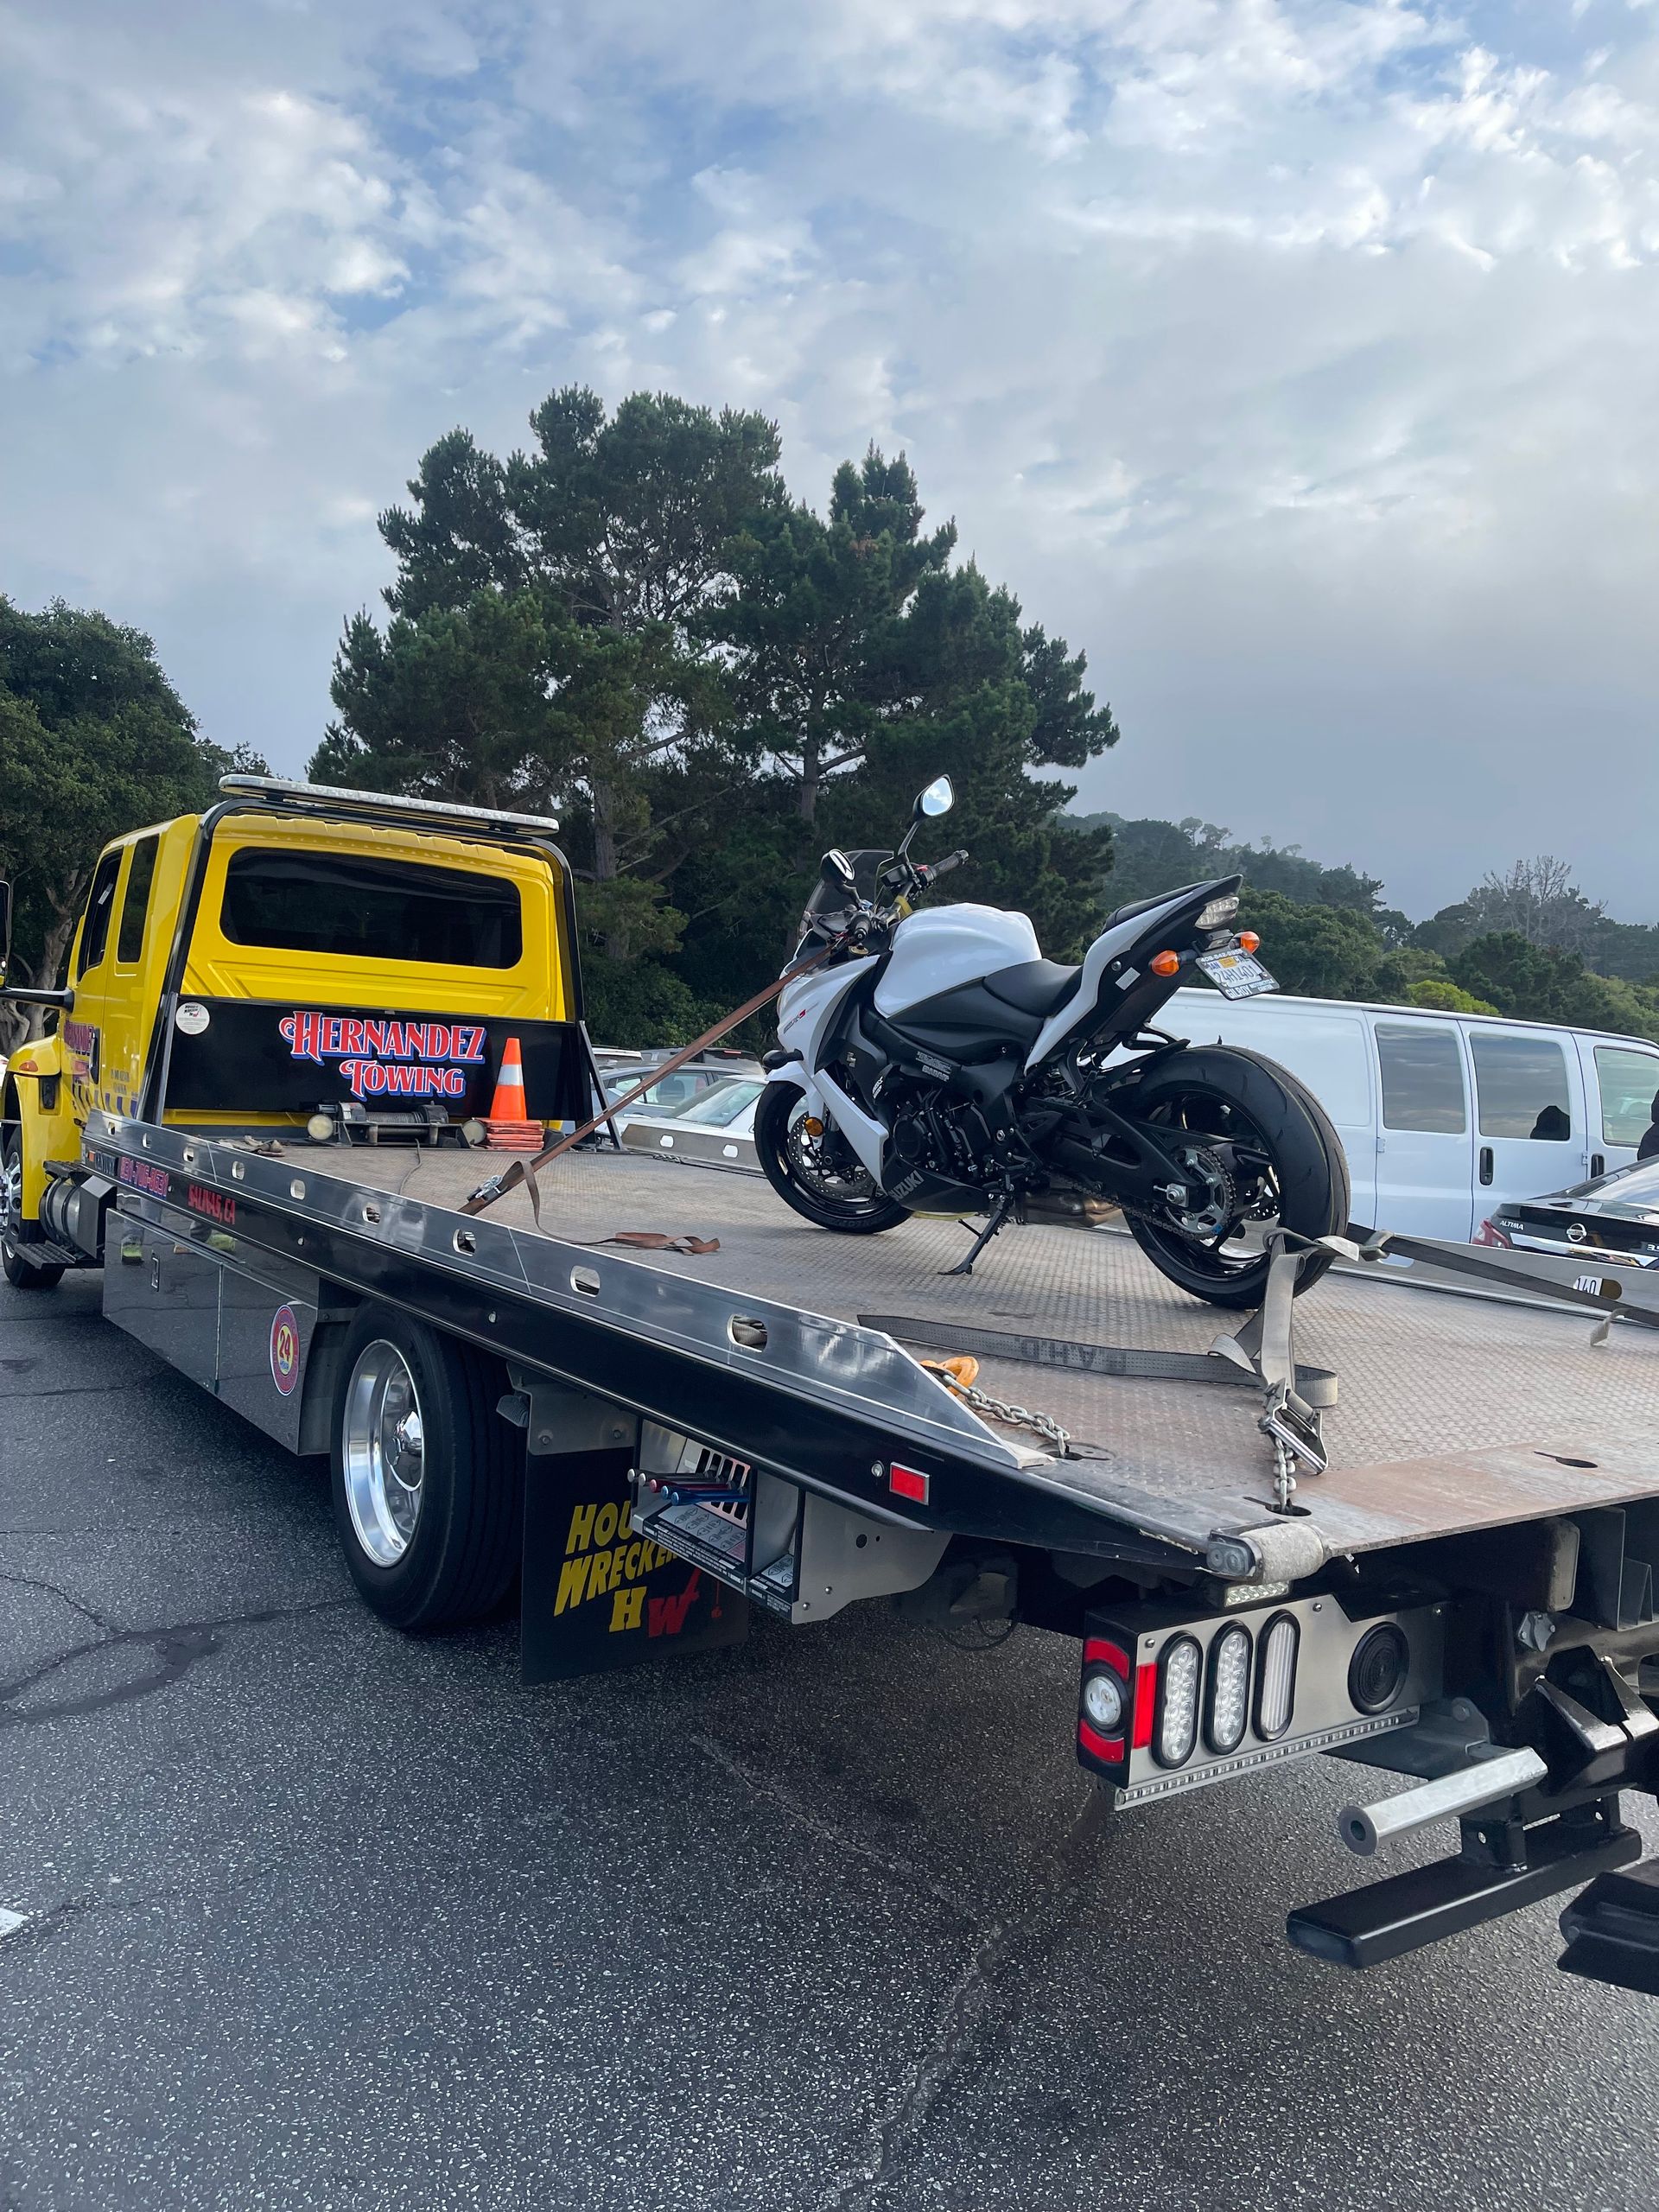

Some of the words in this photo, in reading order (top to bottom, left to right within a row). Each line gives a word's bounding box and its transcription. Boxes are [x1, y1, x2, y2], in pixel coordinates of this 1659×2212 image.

[1225, 985, 1253, 998] GILROY
[279, 1010, 486, 1066] HERNANDEZ
[339, 1058, 467, 1102] TOWING
[888, 1170, 925, 1202] SUZUKI
[1499, 1219, 1525, 1230] ALTIMA
[278, 1329, 291, 1363] 24
[565, 1500, 636, 1556] HOU
